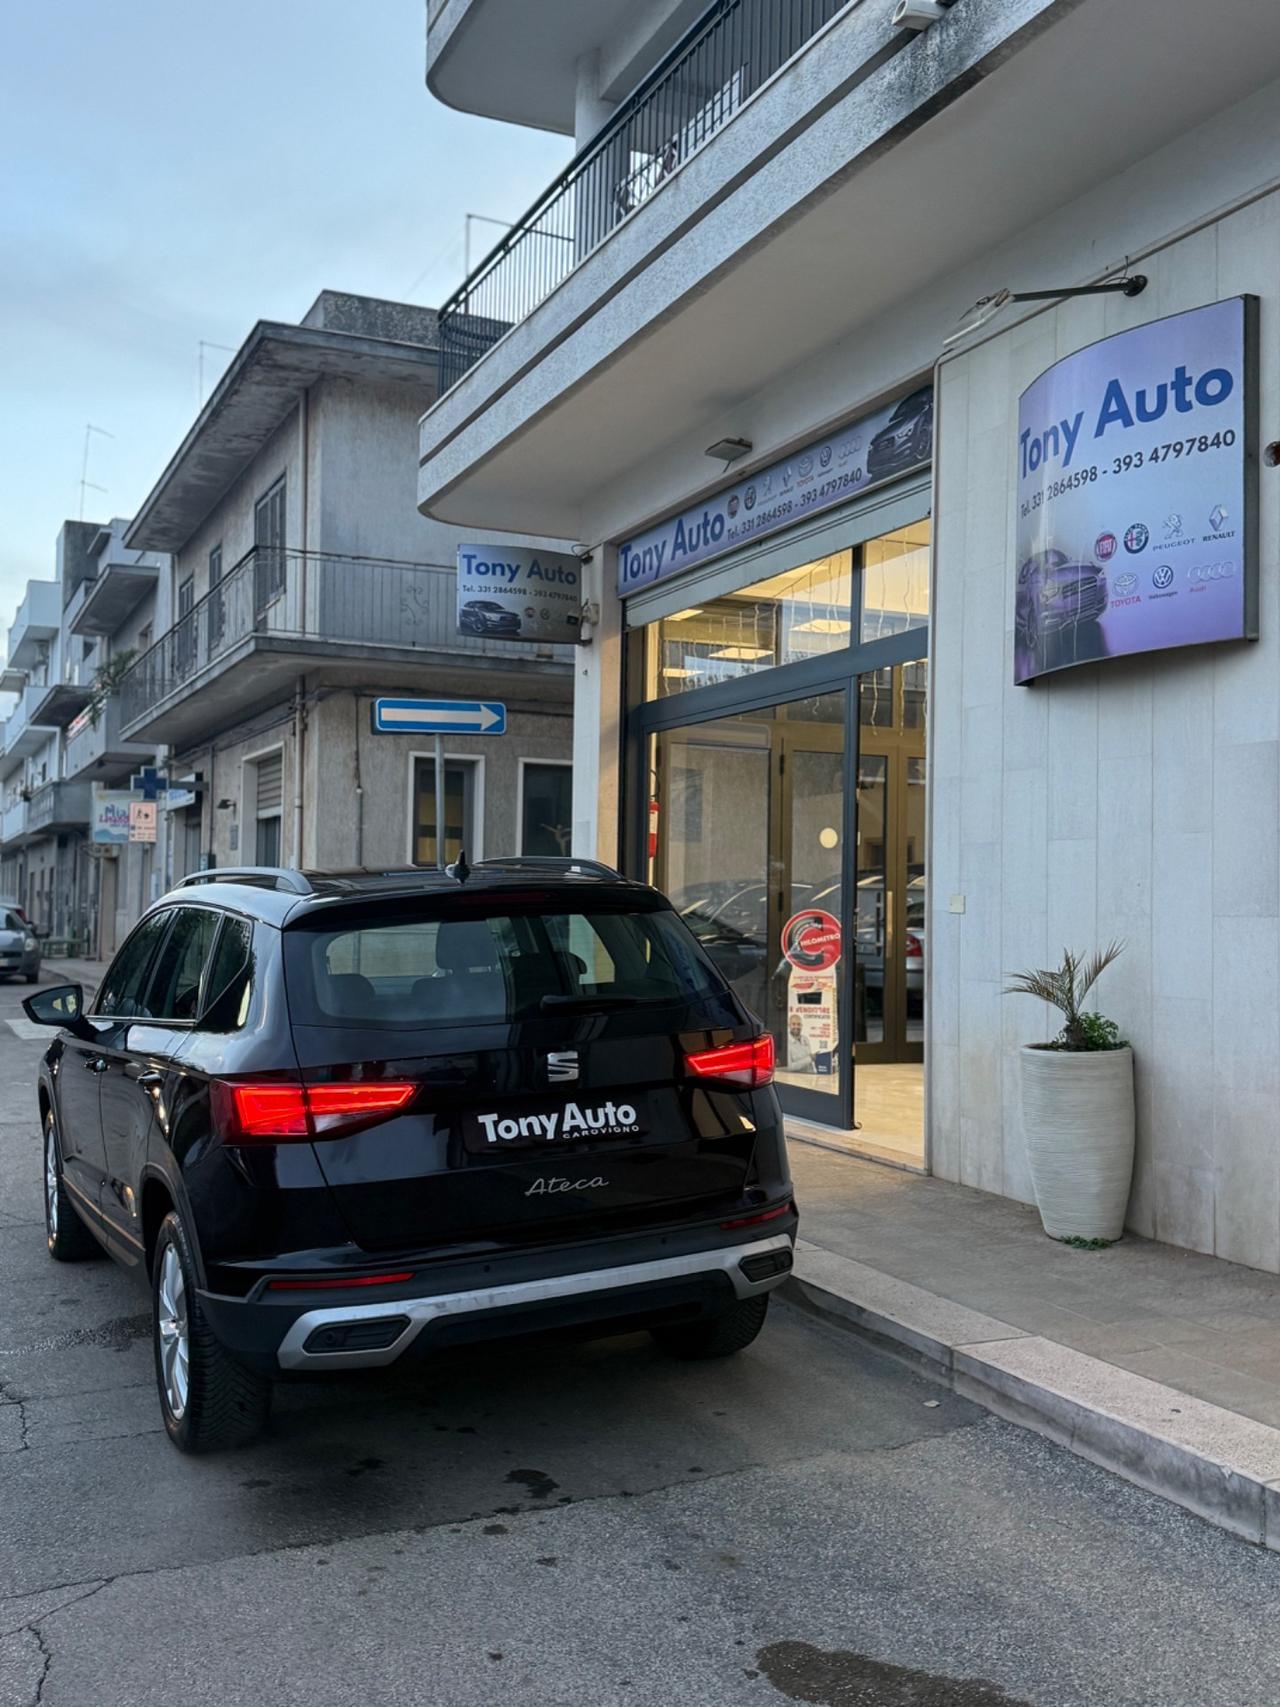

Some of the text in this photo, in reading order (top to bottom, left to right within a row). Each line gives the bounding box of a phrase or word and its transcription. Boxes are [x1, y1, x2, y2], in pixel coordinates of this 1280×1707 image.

[1020, 365, 1234, 480] Tony Auto
[1047, 465, 1098, 500] 2864598
[1112, 452, 1144, 474] 393
[1148, 429, 1236, 465] 4797840
[800, 489, 818, 507] 393
[1152, 538, 1196, 551] PEUGEOT
[1202, 531, 1236, 543] RENAULT
[620, 511, 725, 583] Tony Auto
[462, 554, 577, 585] Tony Auto
[1110, 595, 1142, 609] TOYOTA
[563, 1124, 640, 1139] CAROVIGNO
[524, 1176, 610, 1196] Ateca
